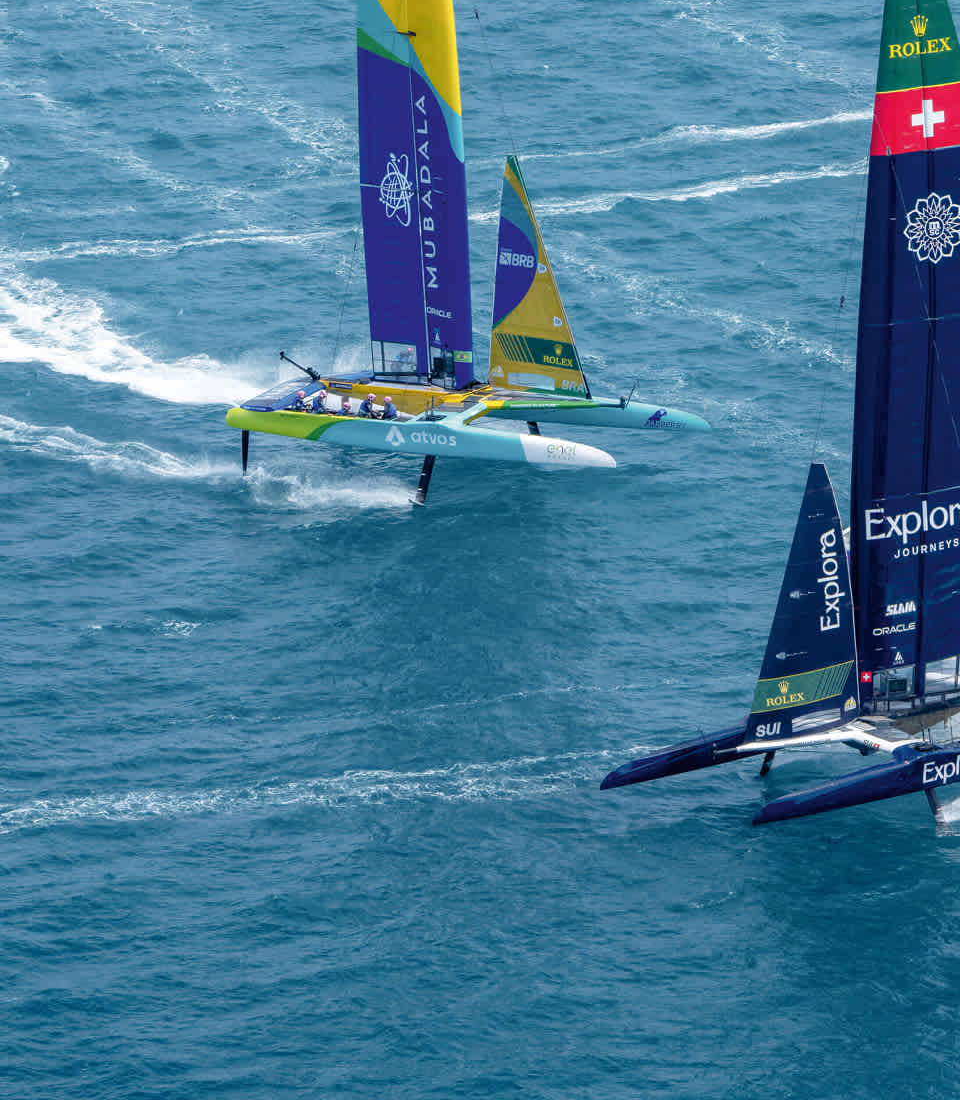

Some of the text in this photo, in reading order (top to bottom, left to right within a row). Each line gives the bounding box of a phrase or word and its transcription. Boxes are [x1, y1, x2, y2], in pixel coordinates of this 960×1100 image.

[887, 37, 952, 59] ROLEX
[415, 95, 440, 288] MUBADALA
[512, 253, 535, 268] BRB
[543, 355, 573, 367] ROLEX
[410, 431, 457, 447] atvos
[894, 538, 960, 559] JOURNEYS
[817, 528, 846, 632] Explora
[872, 622, 917, 636] ORACLE
[765, 692, 805, 707] ROLEX
[755, 721, 782, 738] SUI
